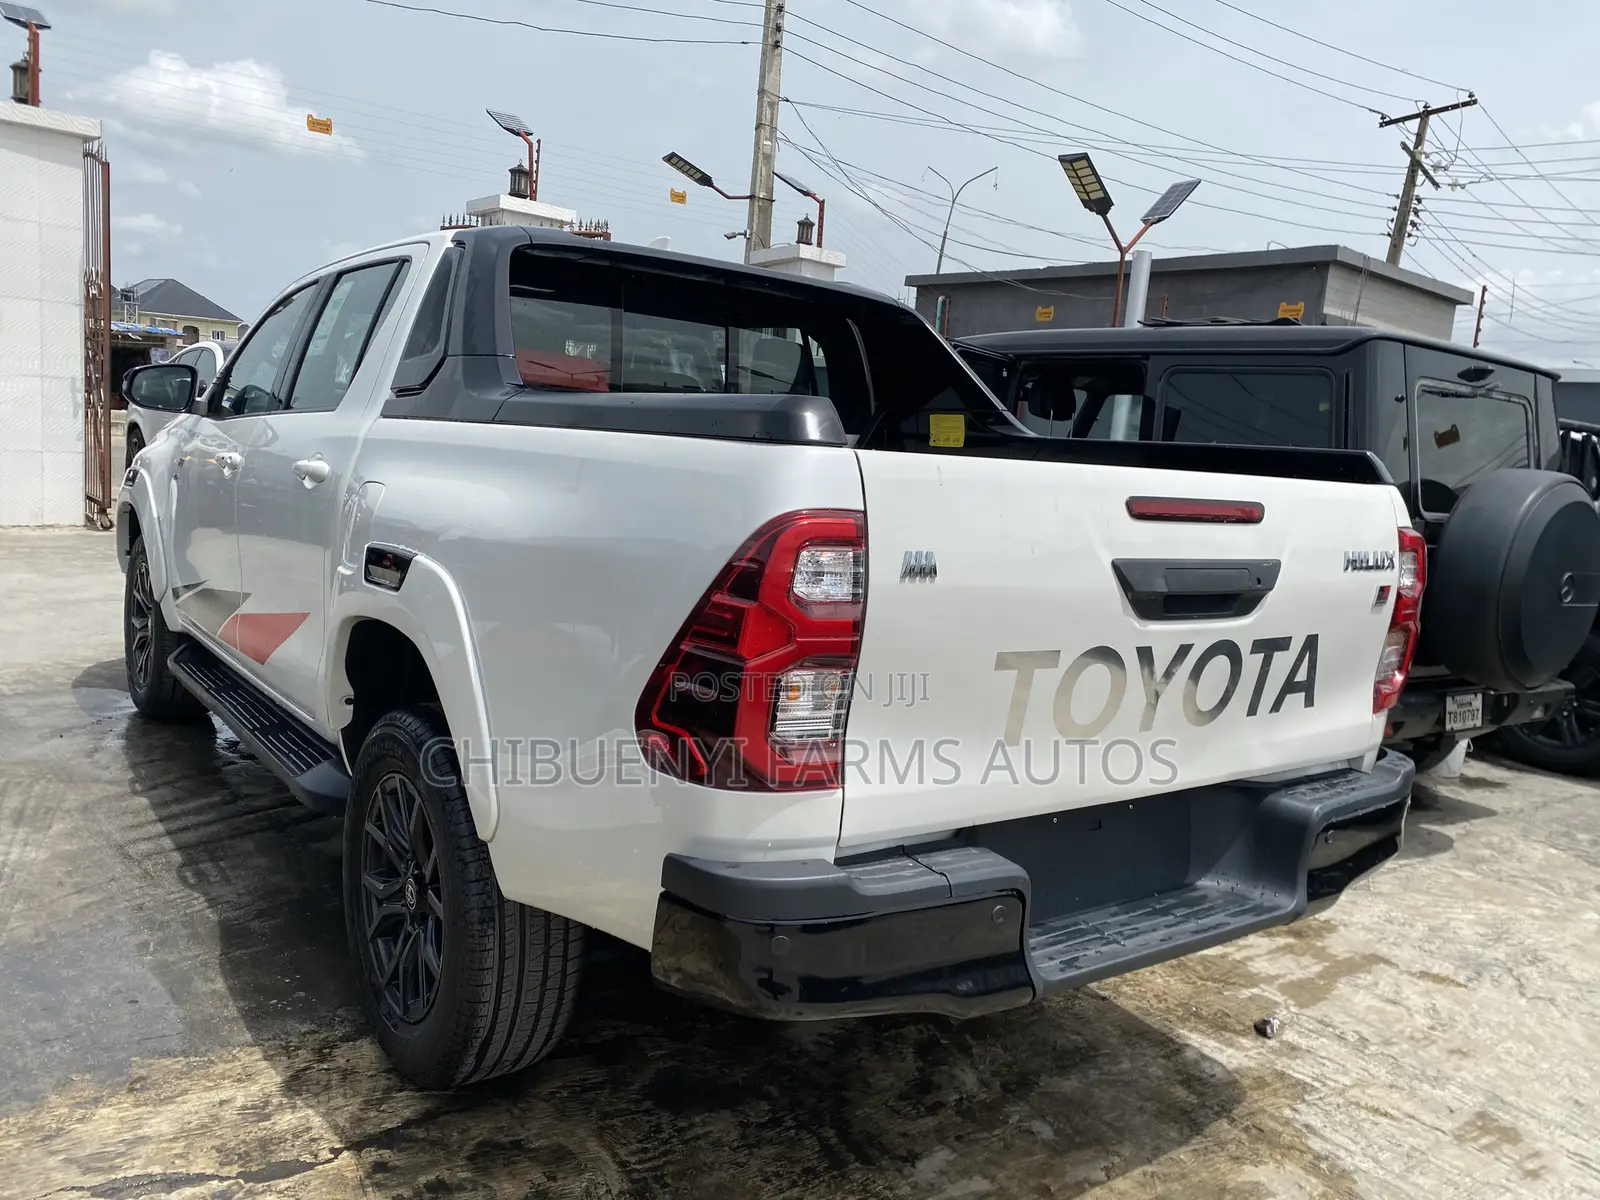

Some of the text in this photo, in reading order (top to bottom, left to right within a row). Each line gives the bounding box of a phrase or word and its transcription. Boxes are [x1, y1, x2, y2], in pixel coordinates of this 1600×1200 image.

[1343, 550, 1396, 572] HILUX
[994, 633, 1319, 747] TOYOTA
[1447, 708, 1480, 725] T810797
